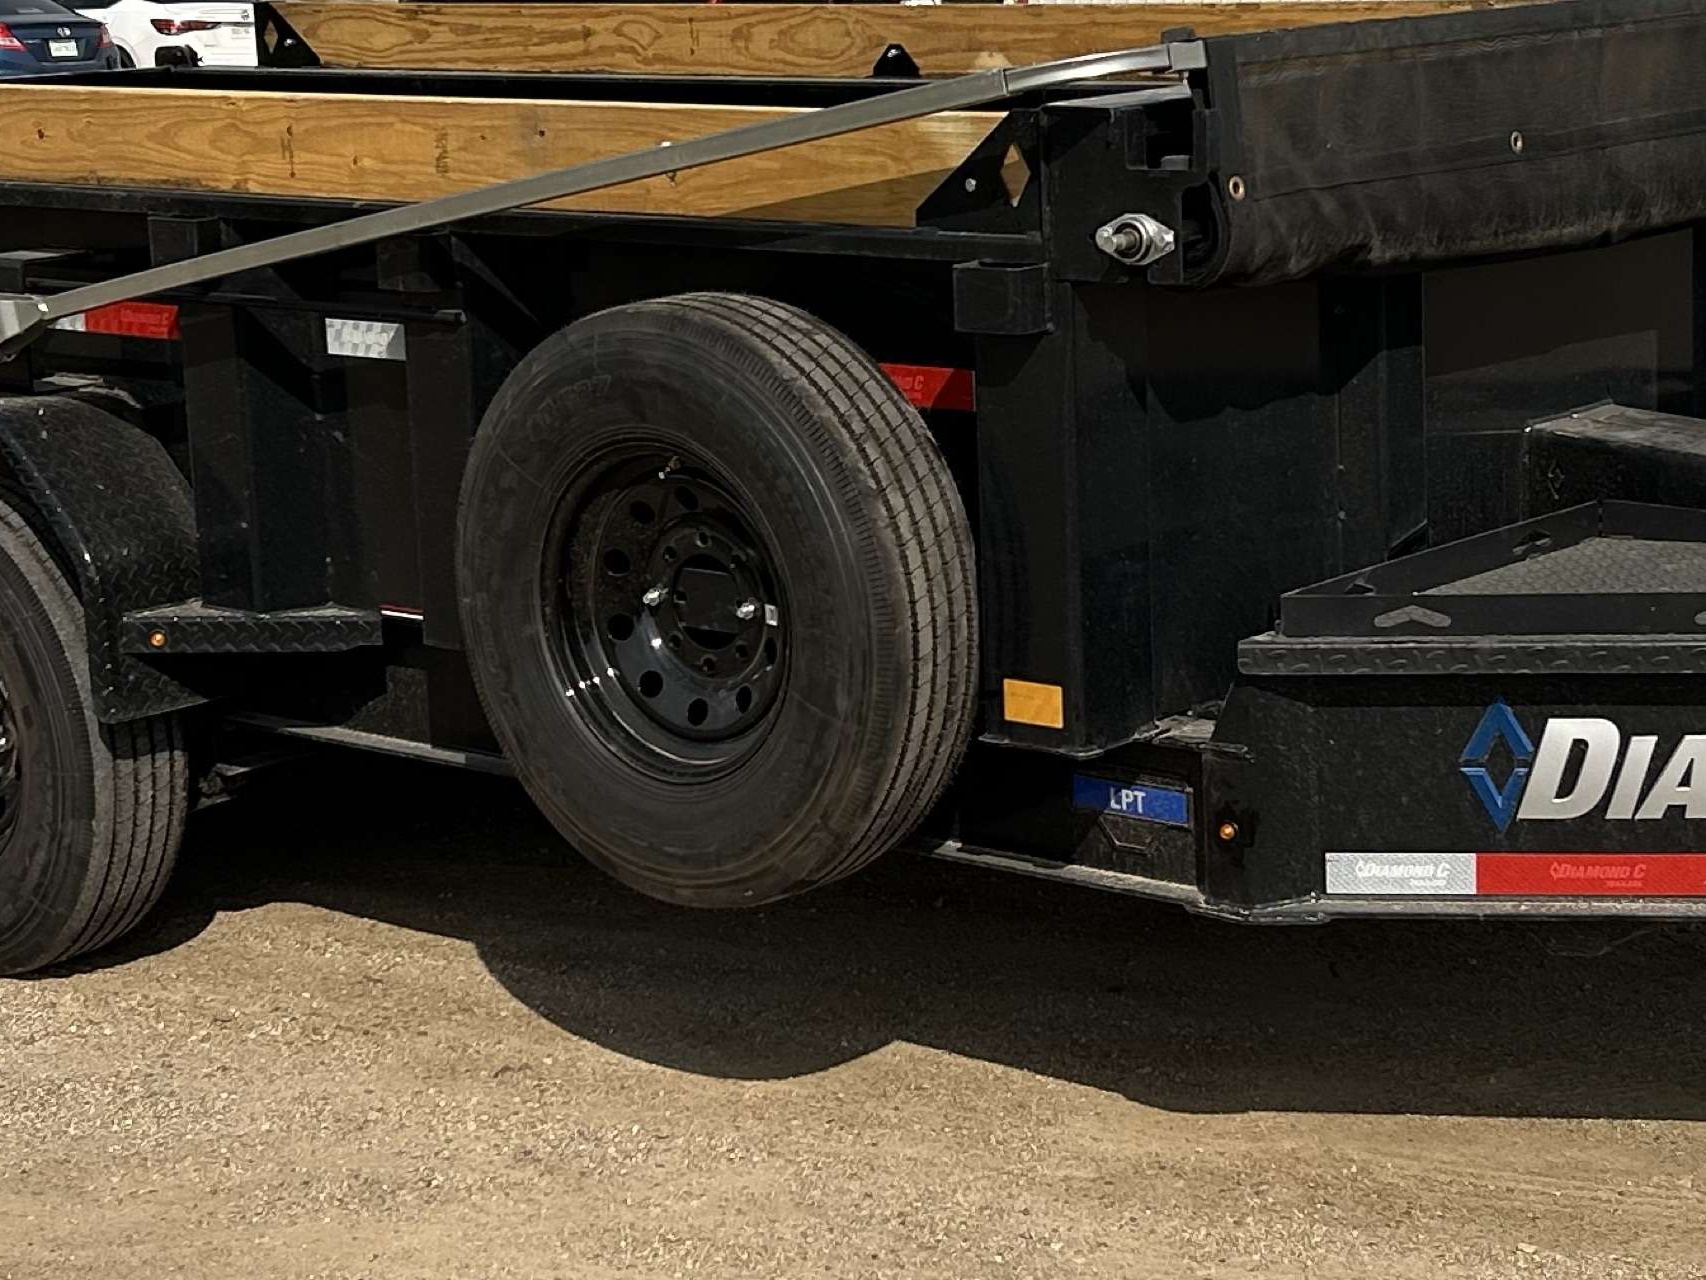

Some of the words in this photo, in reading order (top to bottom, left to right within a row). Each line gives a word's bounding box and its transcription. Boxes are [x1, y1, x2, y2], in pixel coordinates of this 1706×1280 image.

[1109, 787, 1146, 813] LPT
[1362, 862, 1435, 878] DIAMOND
[1556, 863, 1631, 879] DIAMOND
[1633, 863, 1646, 879] C
